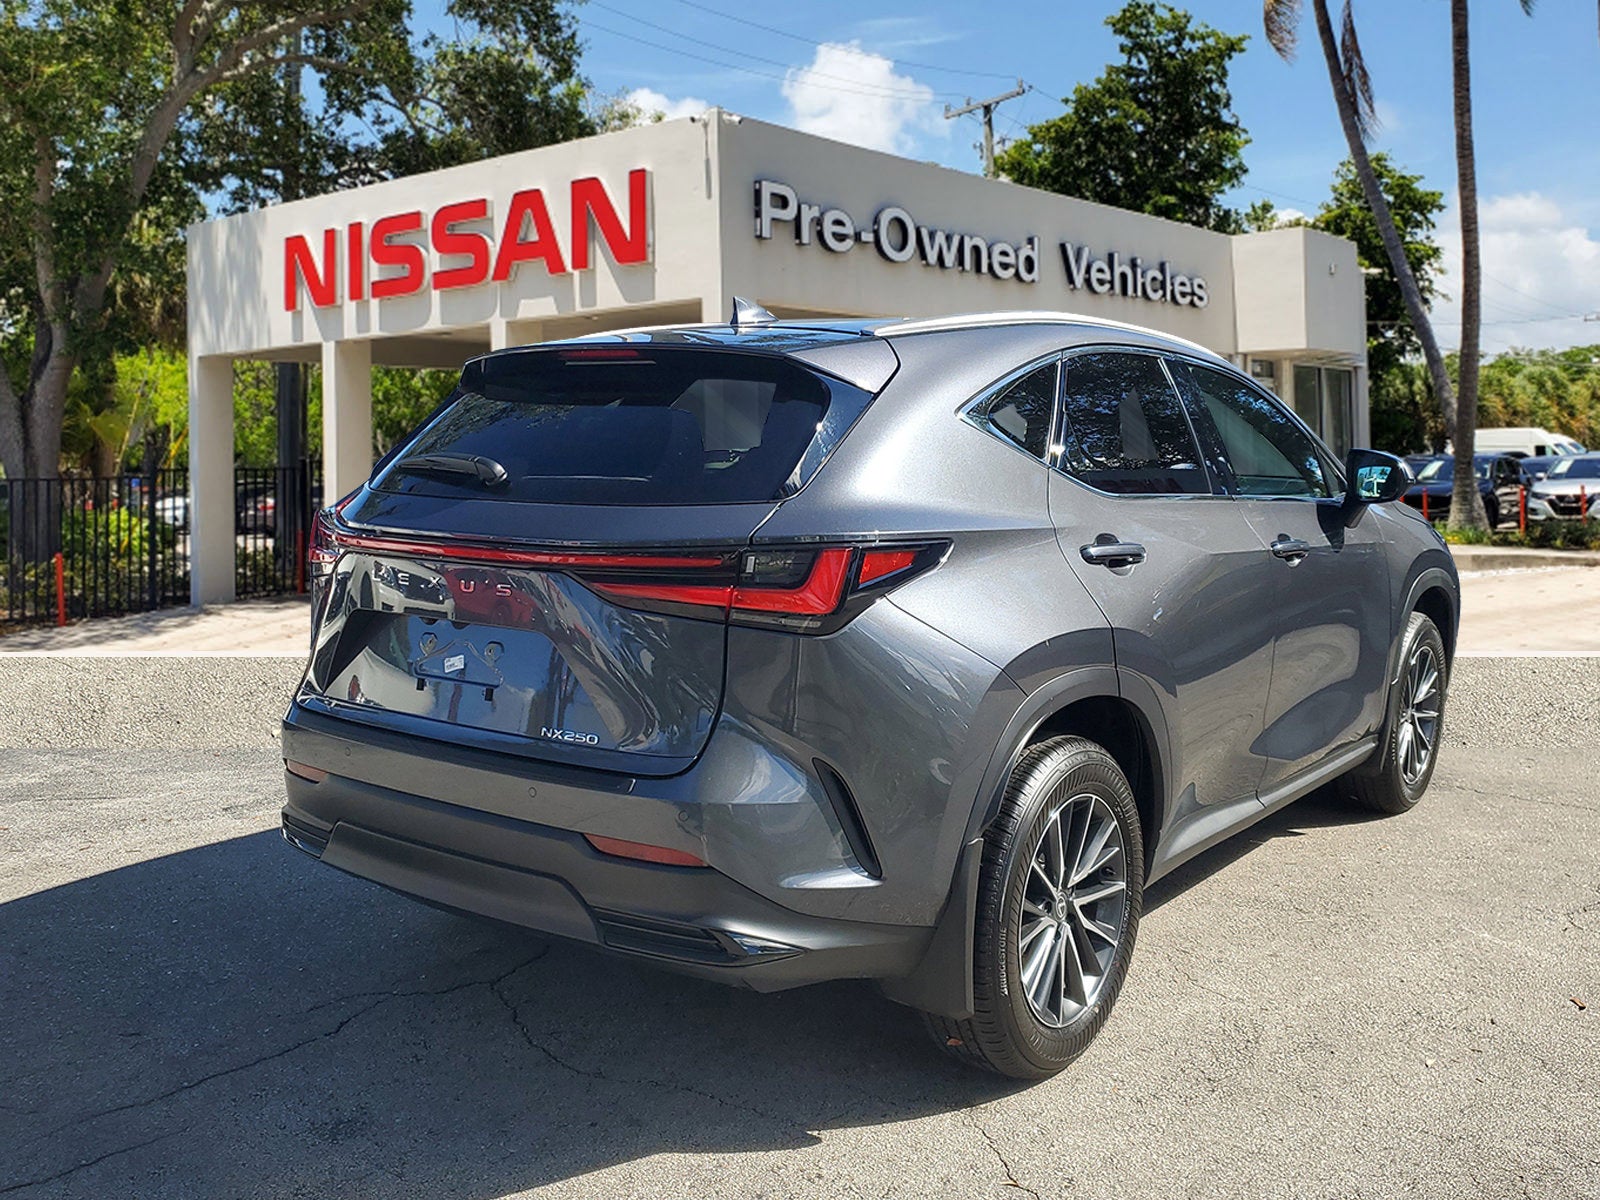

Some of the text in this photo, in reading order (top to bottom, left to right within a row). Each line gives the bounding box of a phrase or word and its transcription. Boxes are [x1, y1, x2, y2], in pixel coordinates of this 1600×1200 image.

[285, 169, 647, 311] NISSAN
[756, 180, 1208, 307] Pre-Owned Vehicles
[372, 569, 511, 597] LEXUS
[540, 726, 599, 745] NX250
